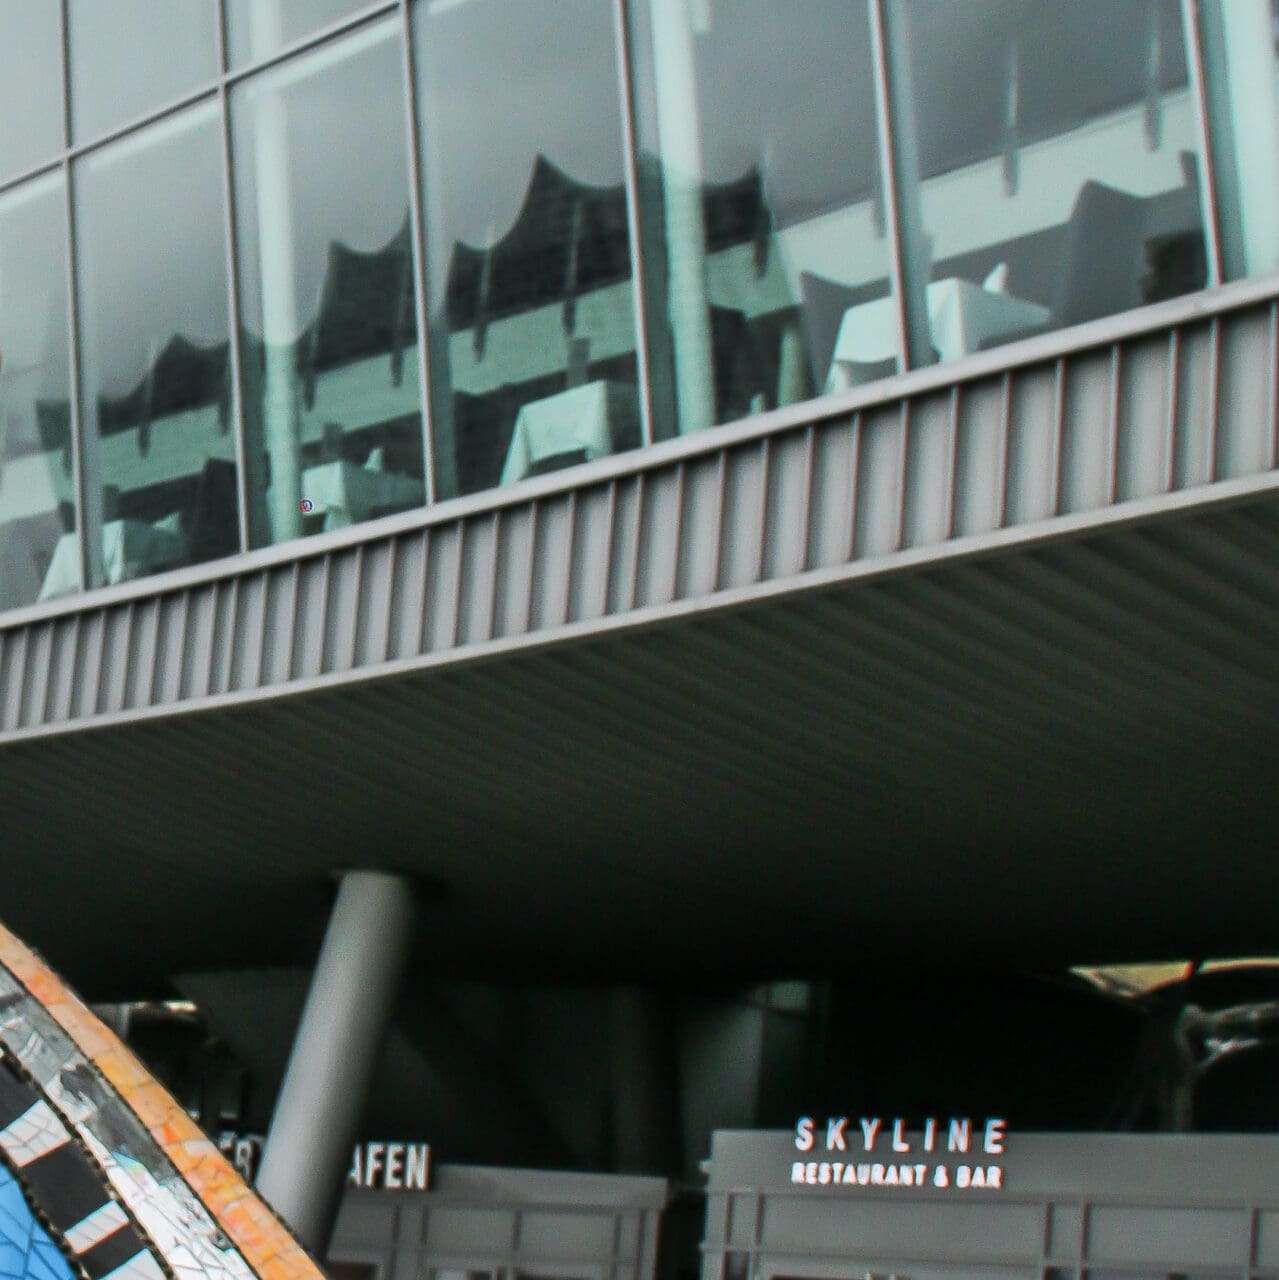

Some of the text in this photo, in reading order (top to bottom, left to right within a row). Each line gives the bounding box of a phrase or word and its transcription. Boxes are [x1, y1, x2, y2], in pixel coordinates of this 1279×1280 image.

[794, 1116, 1007, 1154] SKYLINE
[791, 1161, 1003, 1190] RESTAURANT & BAR
